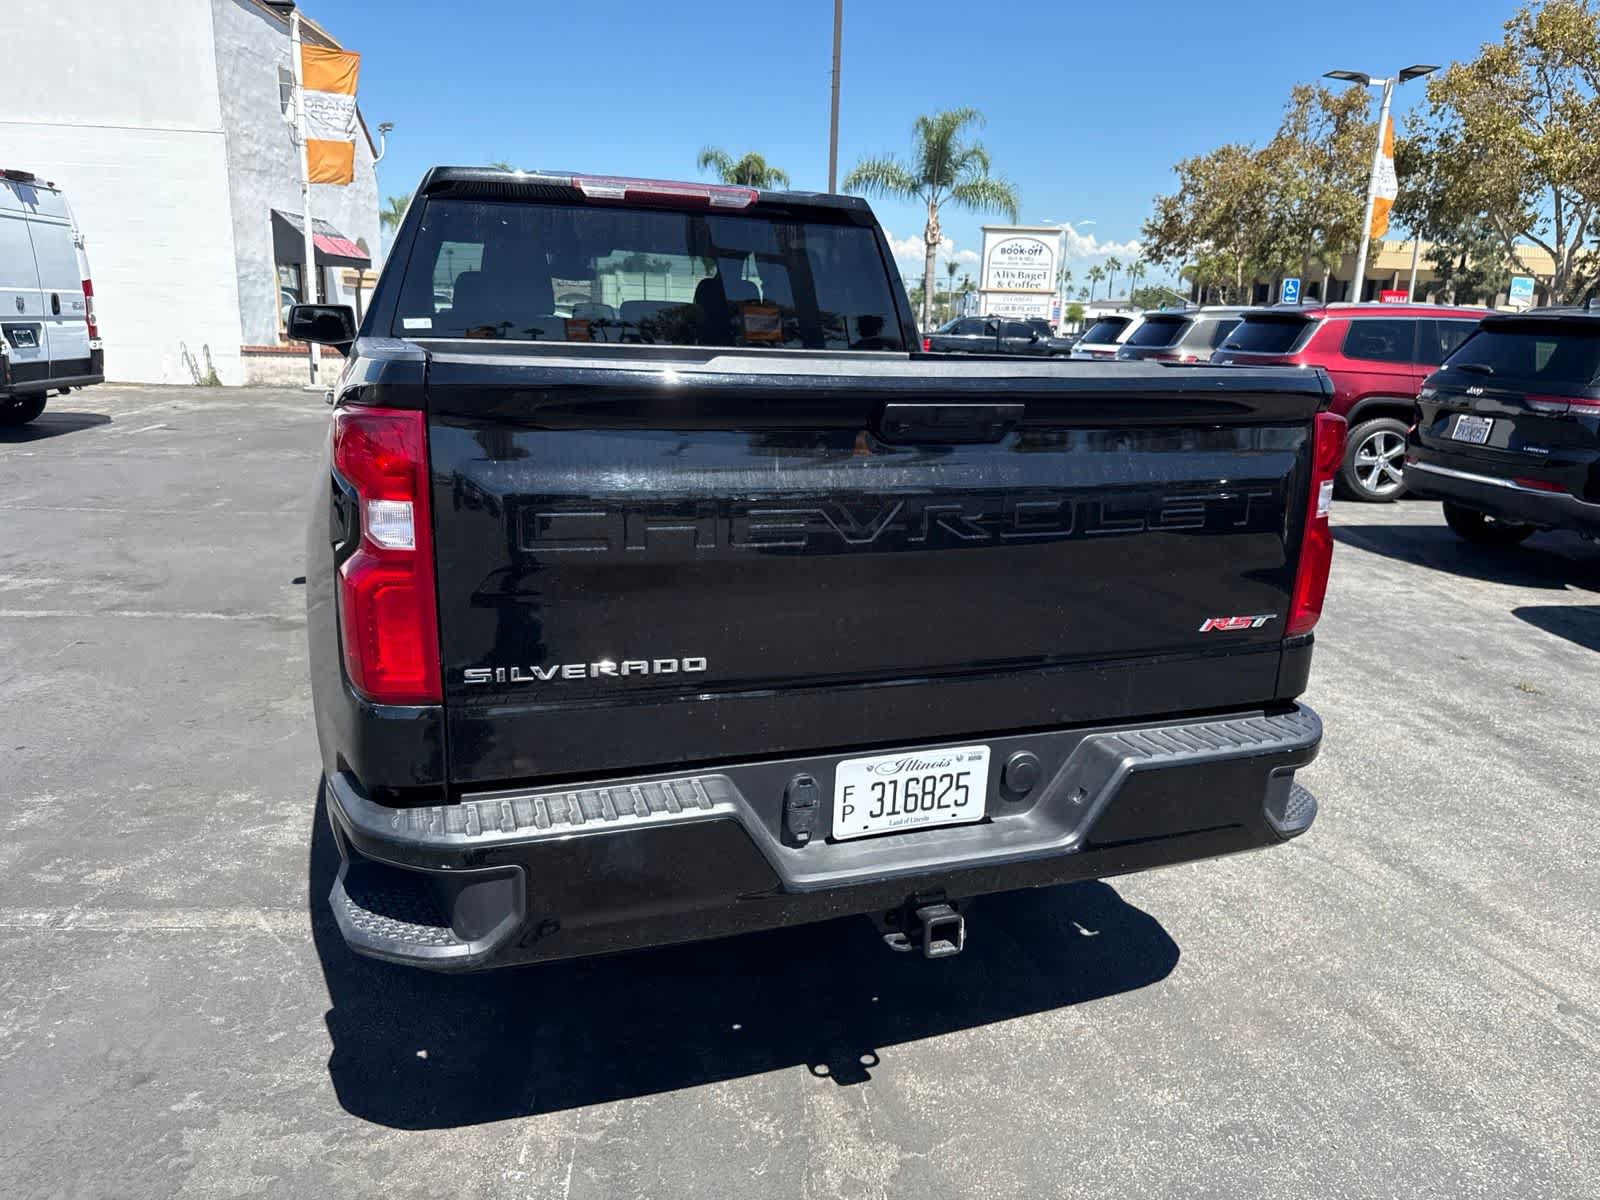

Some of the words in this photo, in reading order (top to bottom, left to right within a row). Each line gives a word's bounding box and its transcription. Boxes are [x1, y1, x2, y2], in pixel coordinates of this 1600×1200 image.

[1007, 280, 1041, 289] Coffee
[1017, 271, 1047, 281] Bagel
[518, 491, 1273, 552] CHEVROLET
[1199, 614, 1278, 632] RST
[463, 657, 707, 684] SILVERADO
[874, 756, 953, 776] Illinois
[869, 771, 971, 818] 316825
